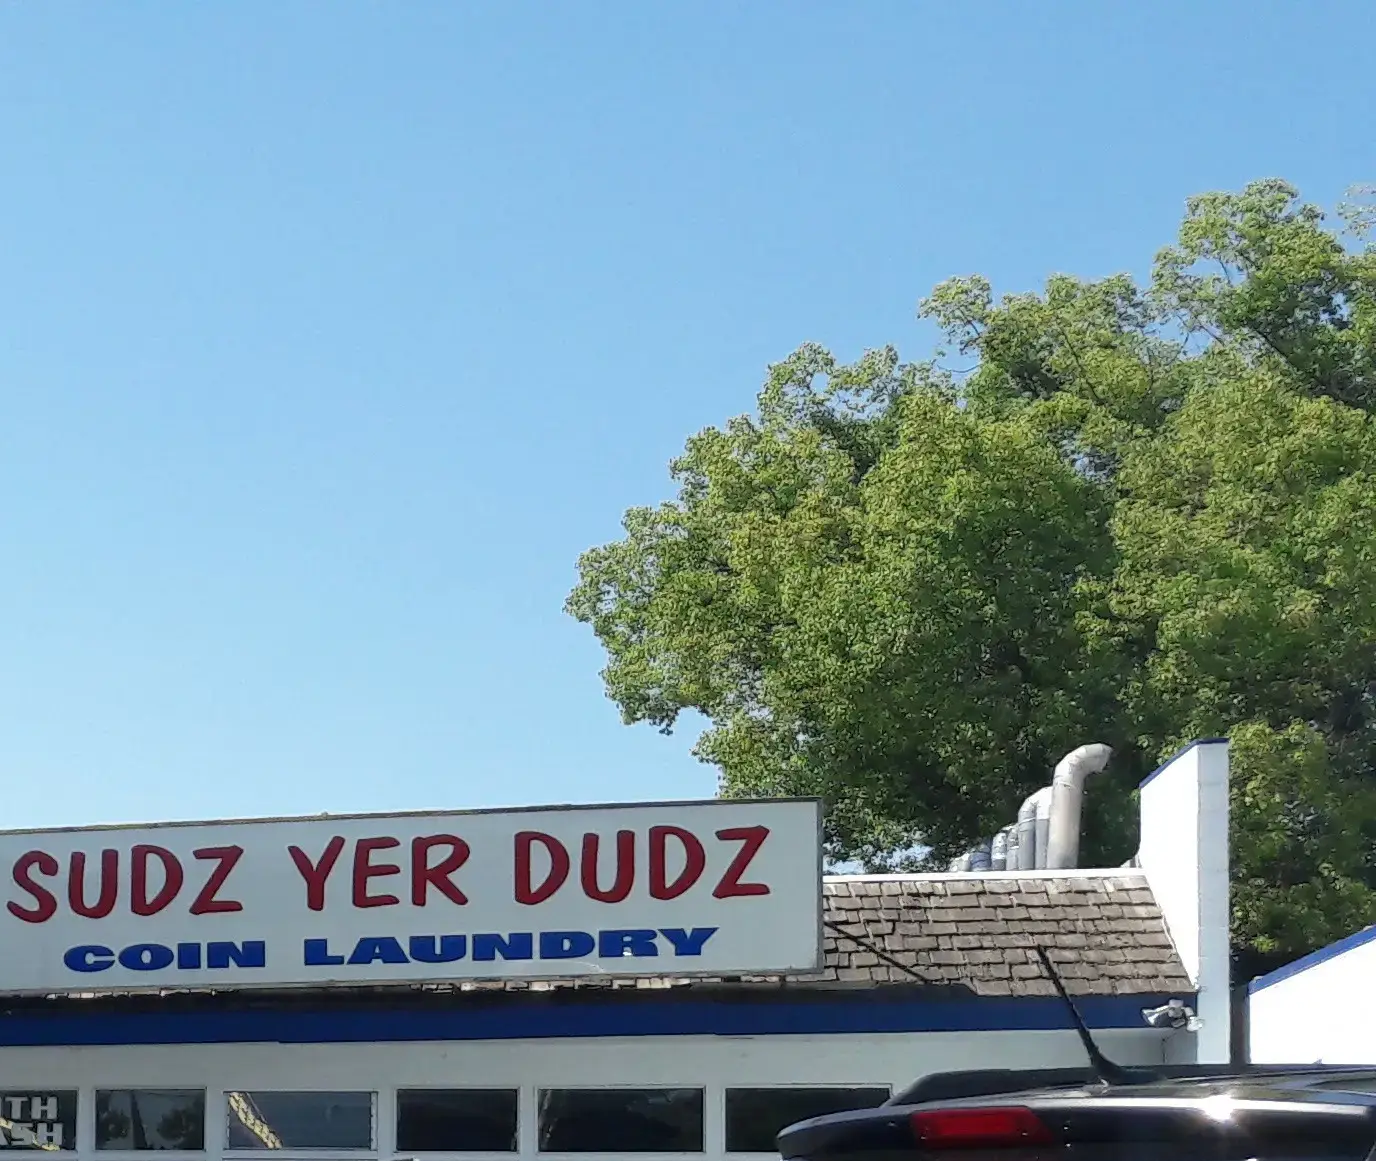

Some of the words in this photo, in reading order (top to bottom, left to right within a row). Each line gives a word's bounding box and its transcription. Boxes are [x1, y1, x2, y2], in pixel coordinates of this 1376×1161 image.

[6, 844, 244, 923] SUDZ
[287, 834, 470, 911] YER
[514, 825, 771, 905] DUDZ
[63, 940, 266, 973] COIN
[303, 927, 720, 966] LAUNDRY
